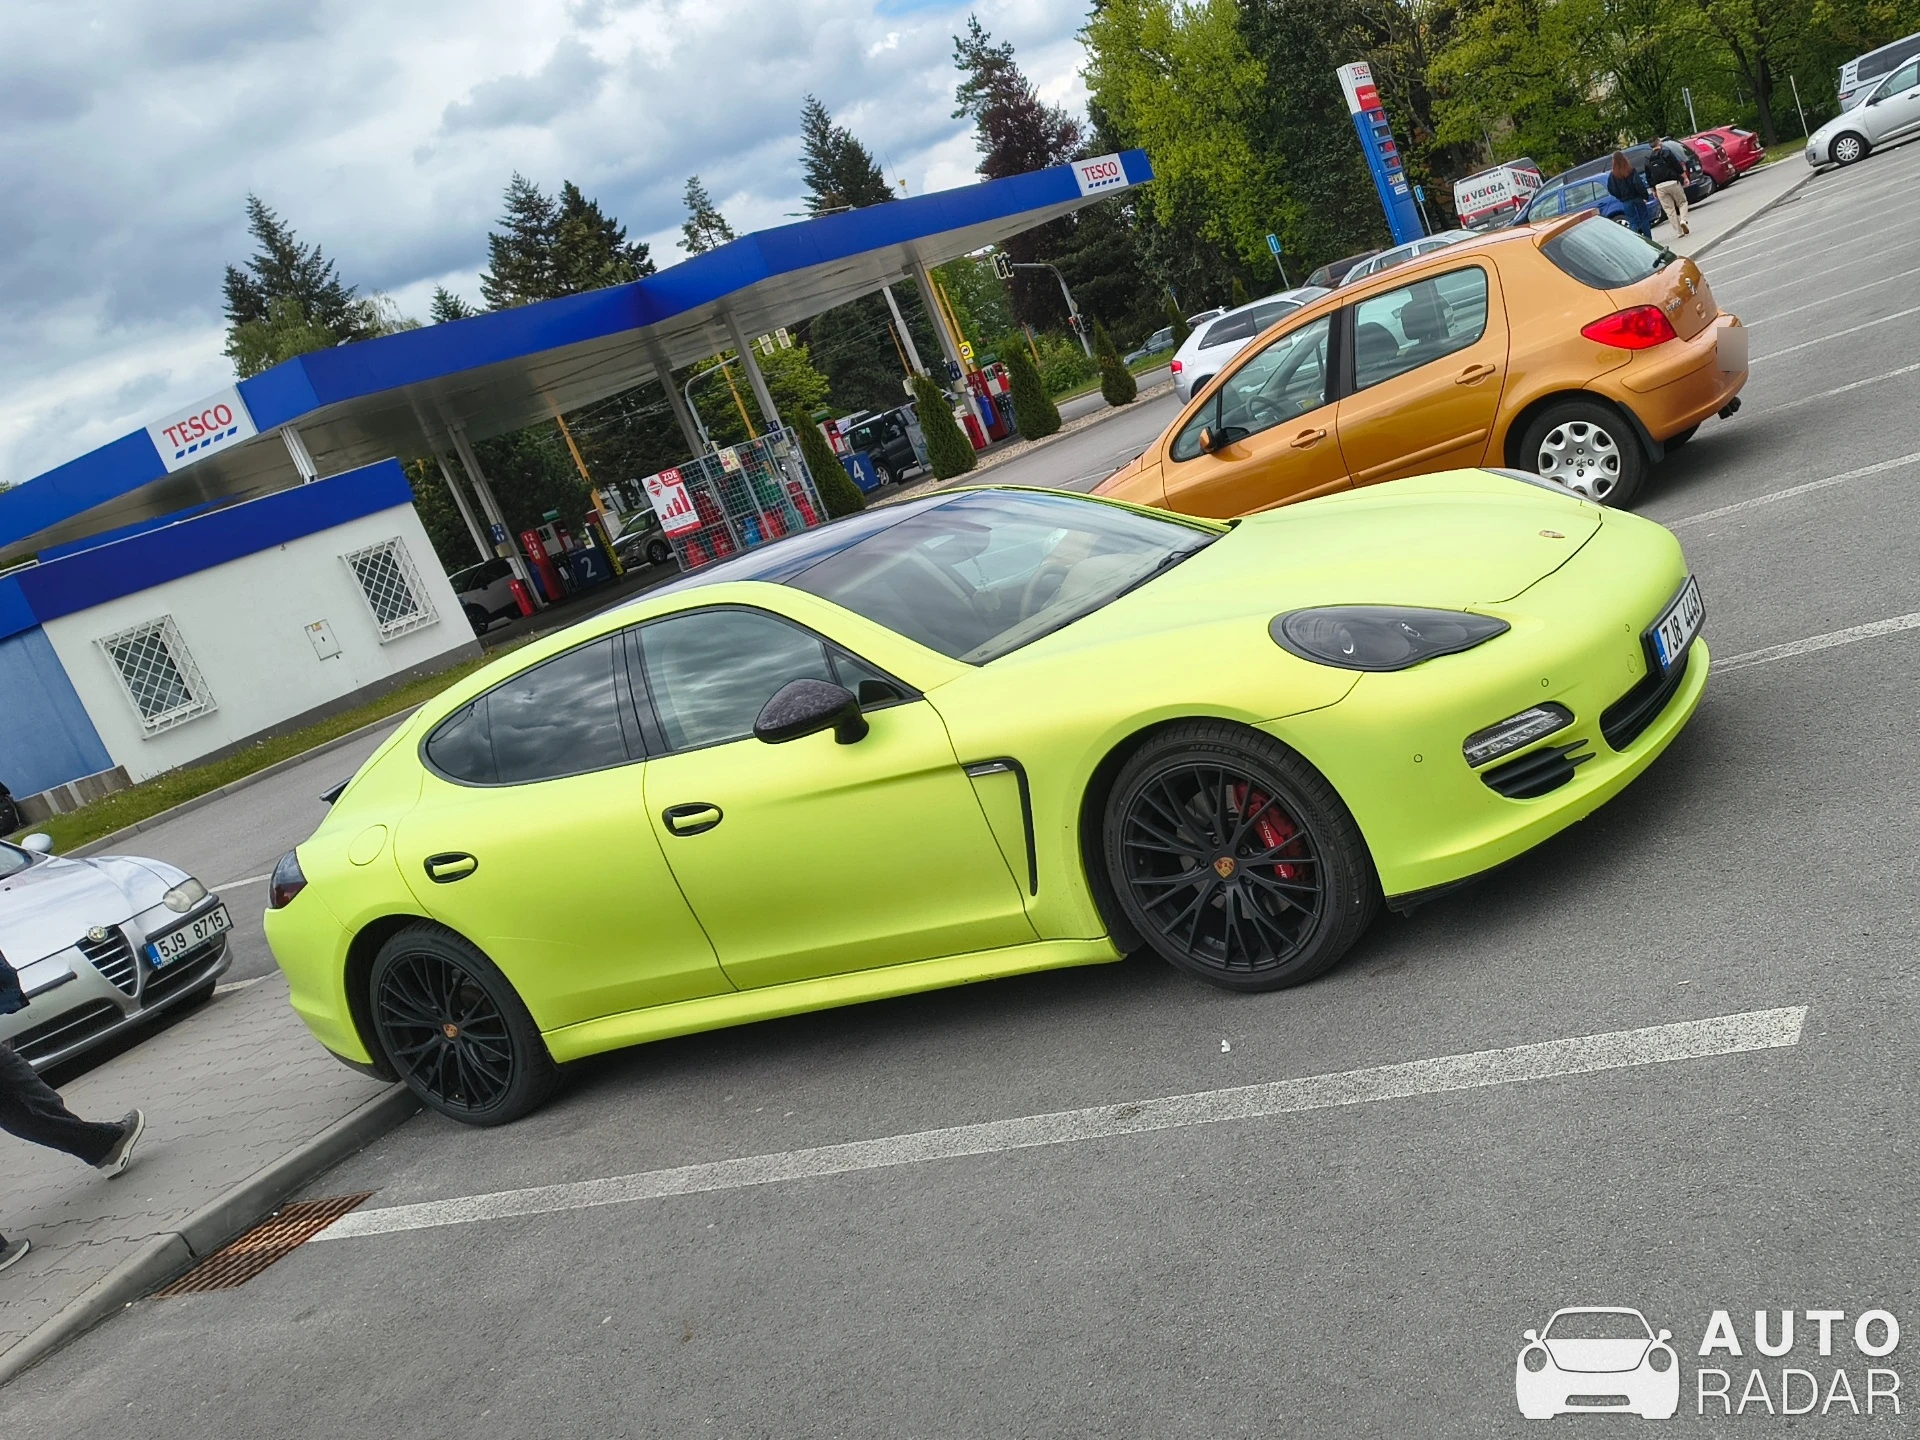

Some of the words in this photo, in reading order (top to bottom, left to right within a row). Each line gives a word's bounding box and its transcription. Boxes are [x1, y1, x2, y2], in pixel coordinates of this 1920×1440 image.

[1081, 161, 1118, 182] TESCO
[1470, 182, 1505, 200] VEKRA
[162, 404, 233, 448] TESCO
[767, 421, 778, 432] 34
[661, 470, 678, 481] ZDE
[853, 460, 865, 481] 4
[491, 523, 502, 534] 12
[524, 532, 534, 543] 12
[580, 556, 597, 578] 2
[1662, 615, 1683, 658] 7J8
[1682, 587, 1700, 630] 4448
[158, 932, 187, 957] 5J9
[192, 911, 224, 940] 8715
